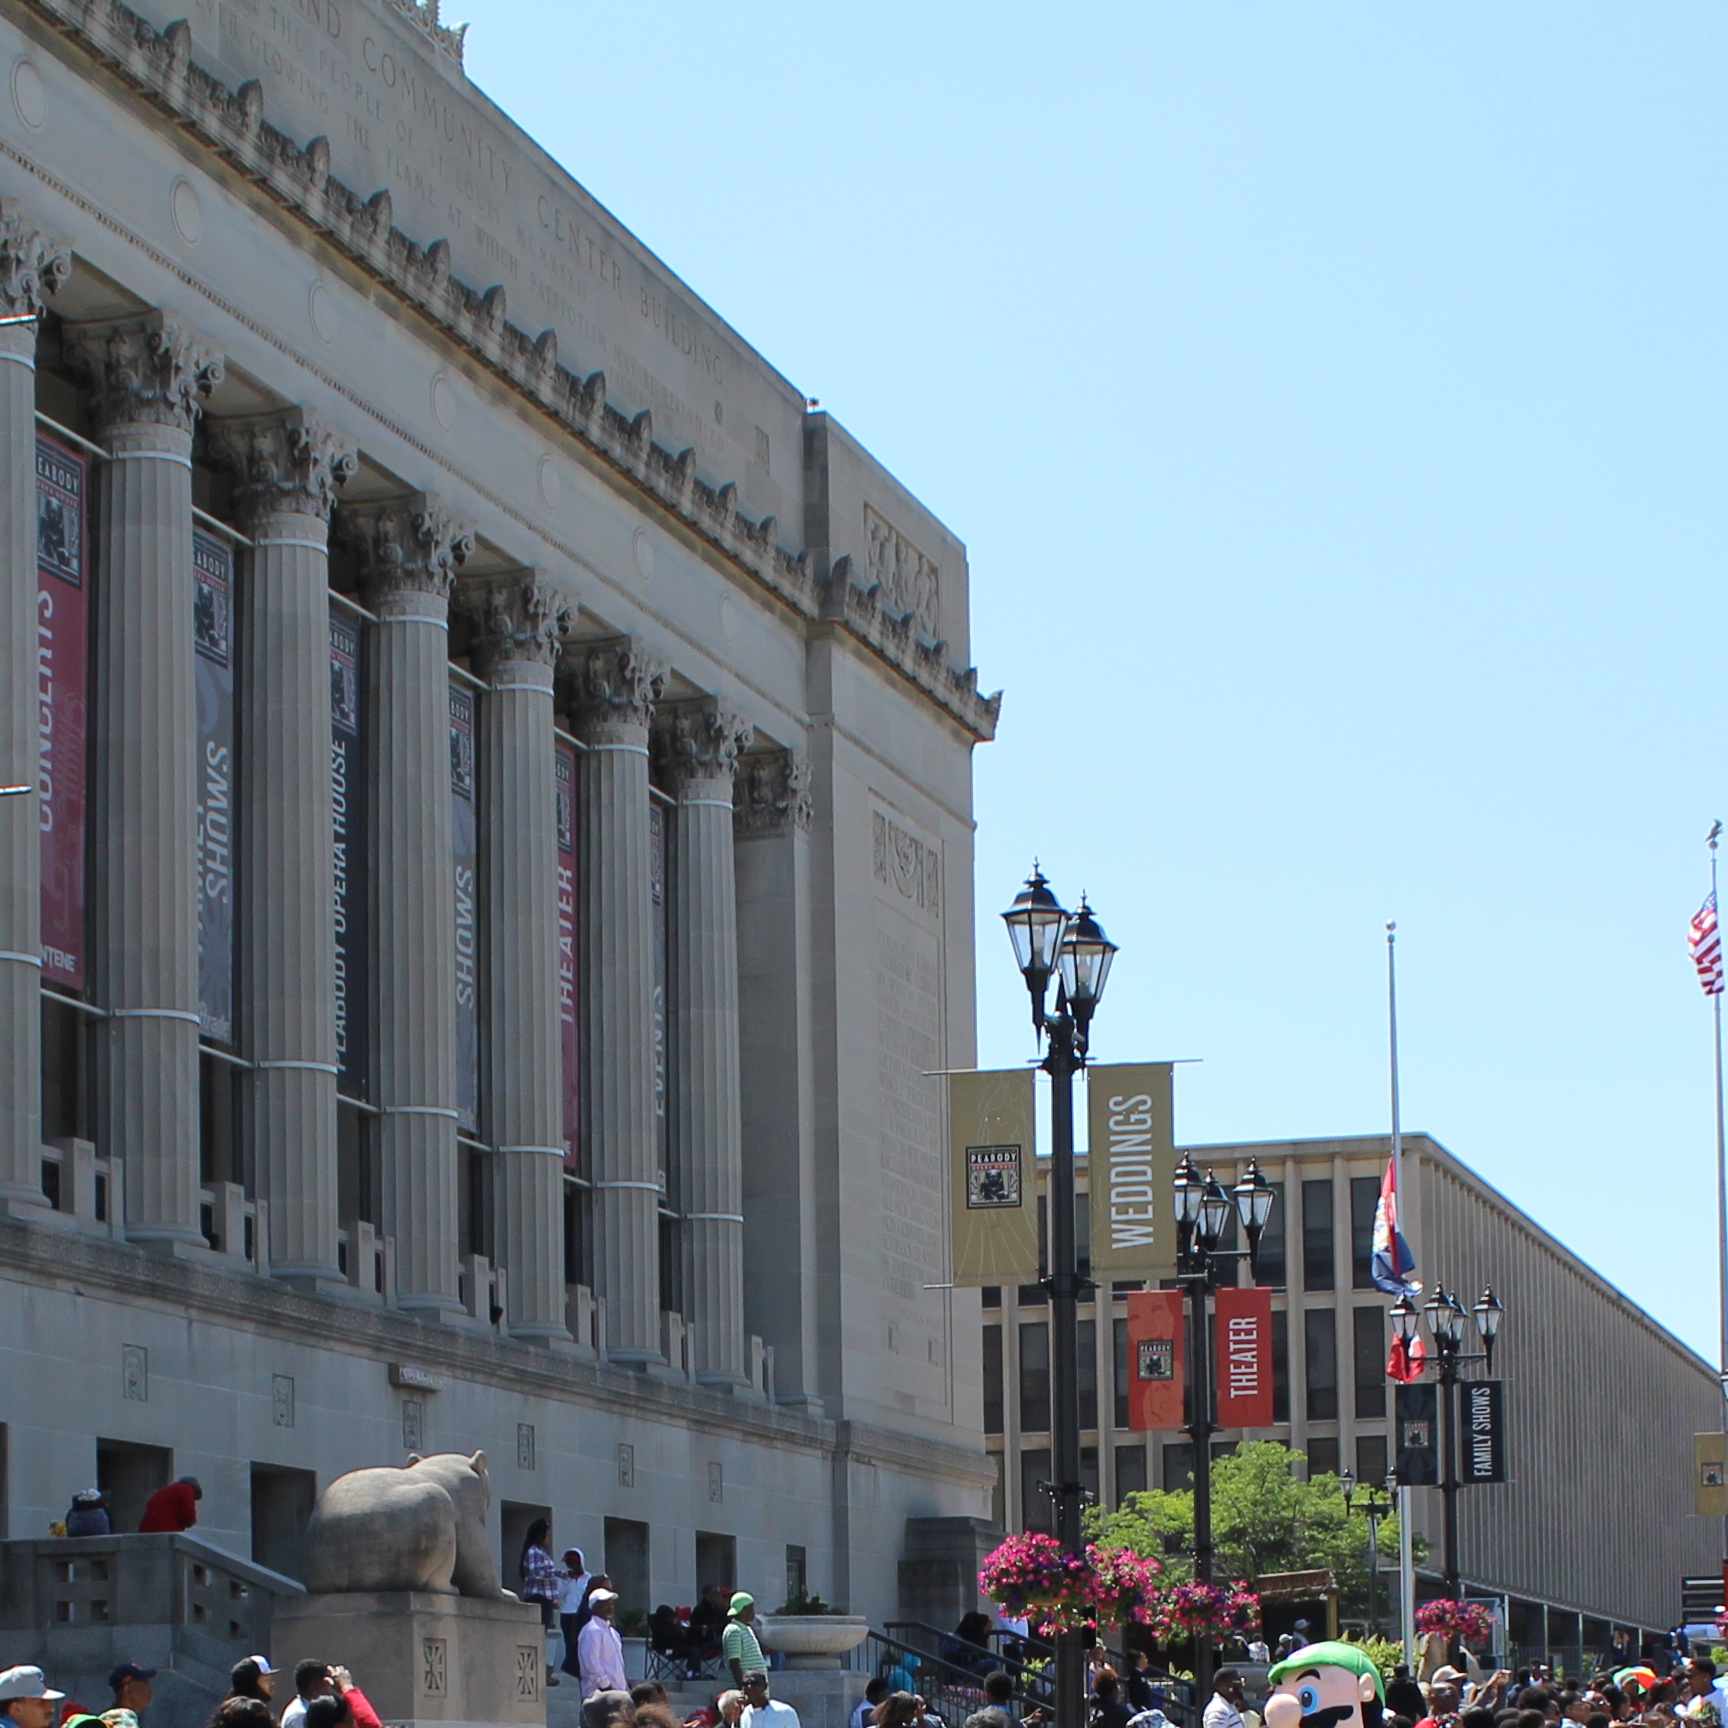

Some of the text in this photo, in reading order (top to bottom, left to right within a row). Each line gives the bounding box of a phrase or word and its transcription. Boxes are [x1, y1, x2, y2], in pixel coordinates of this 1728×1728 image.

[271, 6, 302, 52] THE
[319, 50, 382, 122] PEOPLE
[249, 32, 328, 115] GLOWING
[346, 112, 372, 153] THE
[388, 149, 436, 207] FLAME
[447, 203, 462, 228] AT
[475, 223, 518, 278] WHICH
[363, 36, 513, 193] COMMUNITY
[537, 195, 625, 302] CENTER
[640, 286, 723, 385] BUILDING
[37, 456, 79, 493] EABODY
[196, 551, 226, 579] ABODY
[970, 1152, 1017, 1163] PEABODY
[1108, 1094, 1154, 1250] WEDDINGS
[1229, 1316, 1258, 1399] THEATER
[1471, 1387, 1492, 1476] FAMILY SHOWS
